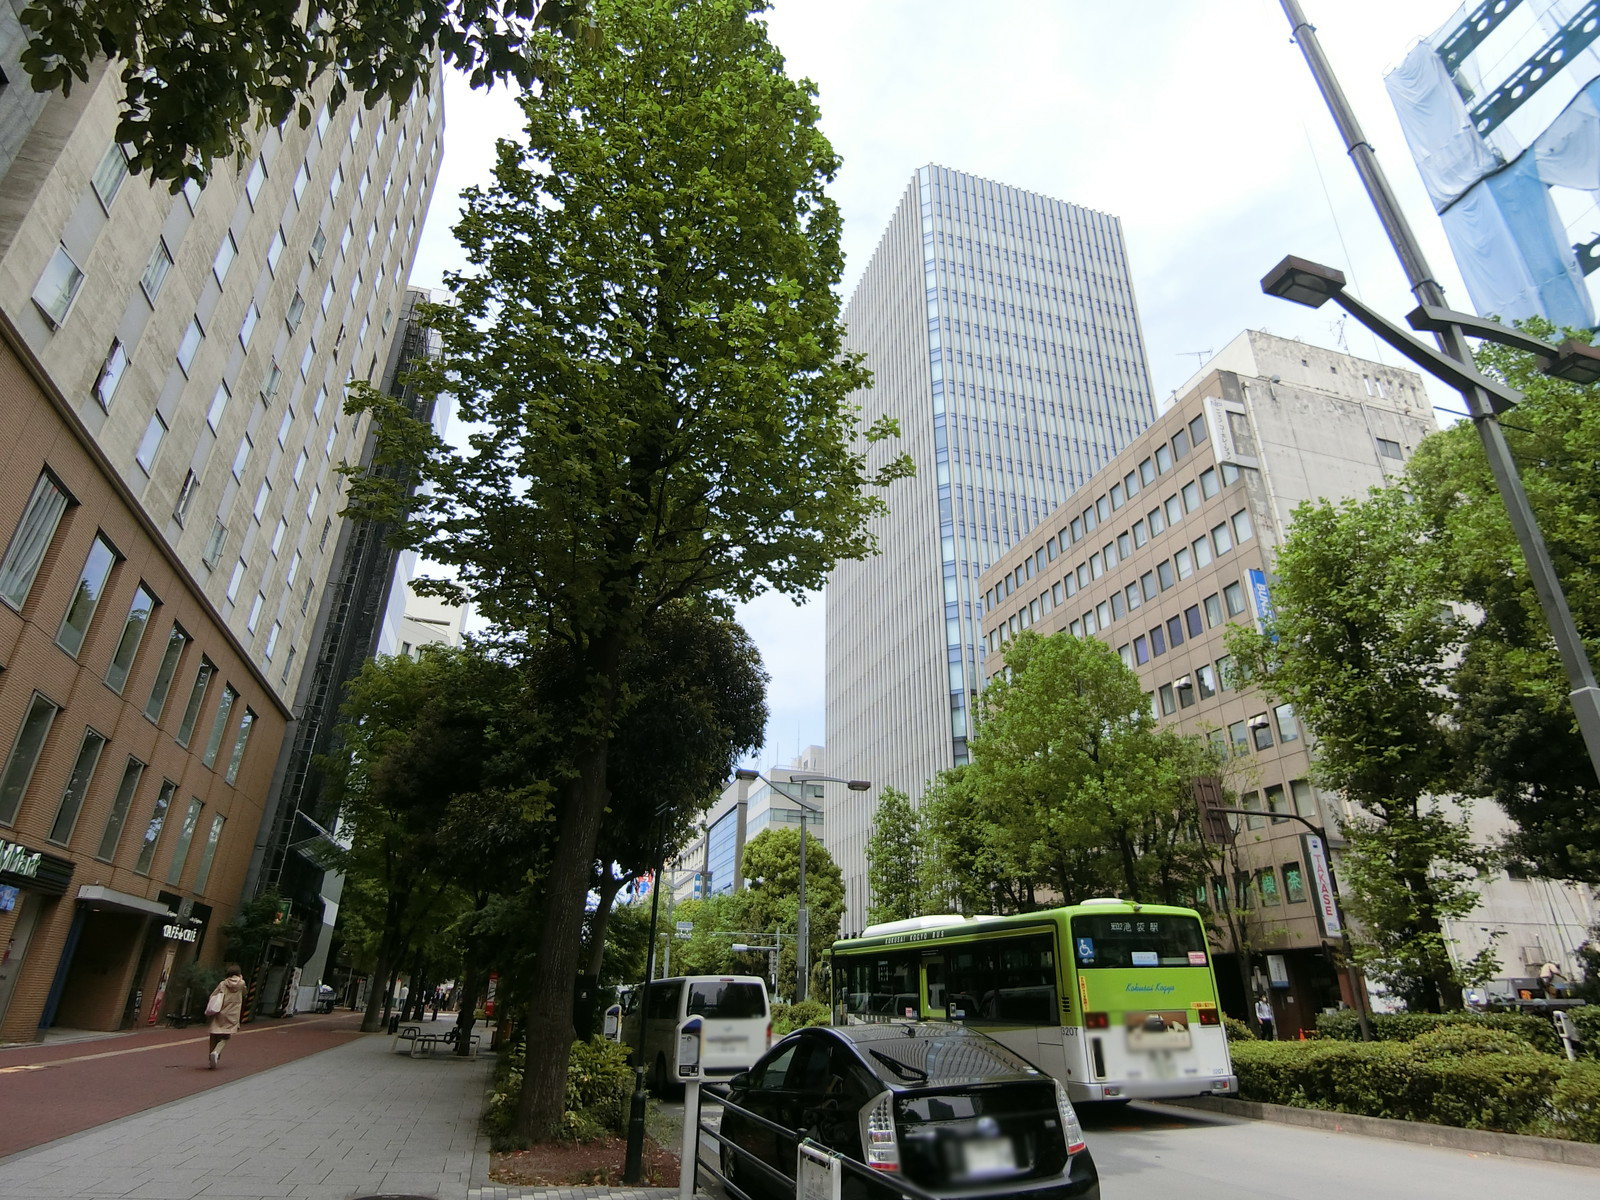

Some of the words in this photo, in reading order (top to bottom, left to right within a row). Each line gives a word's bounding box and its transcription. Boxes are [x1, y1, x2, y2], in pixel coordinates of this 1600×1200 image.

[1313, 854, 1333, 916] TAKASE
[909, 932, 928, 941] KOGYO
[932, 930, 944, 939] BUS
[1061, 1026, 1078, 1037] 3207
